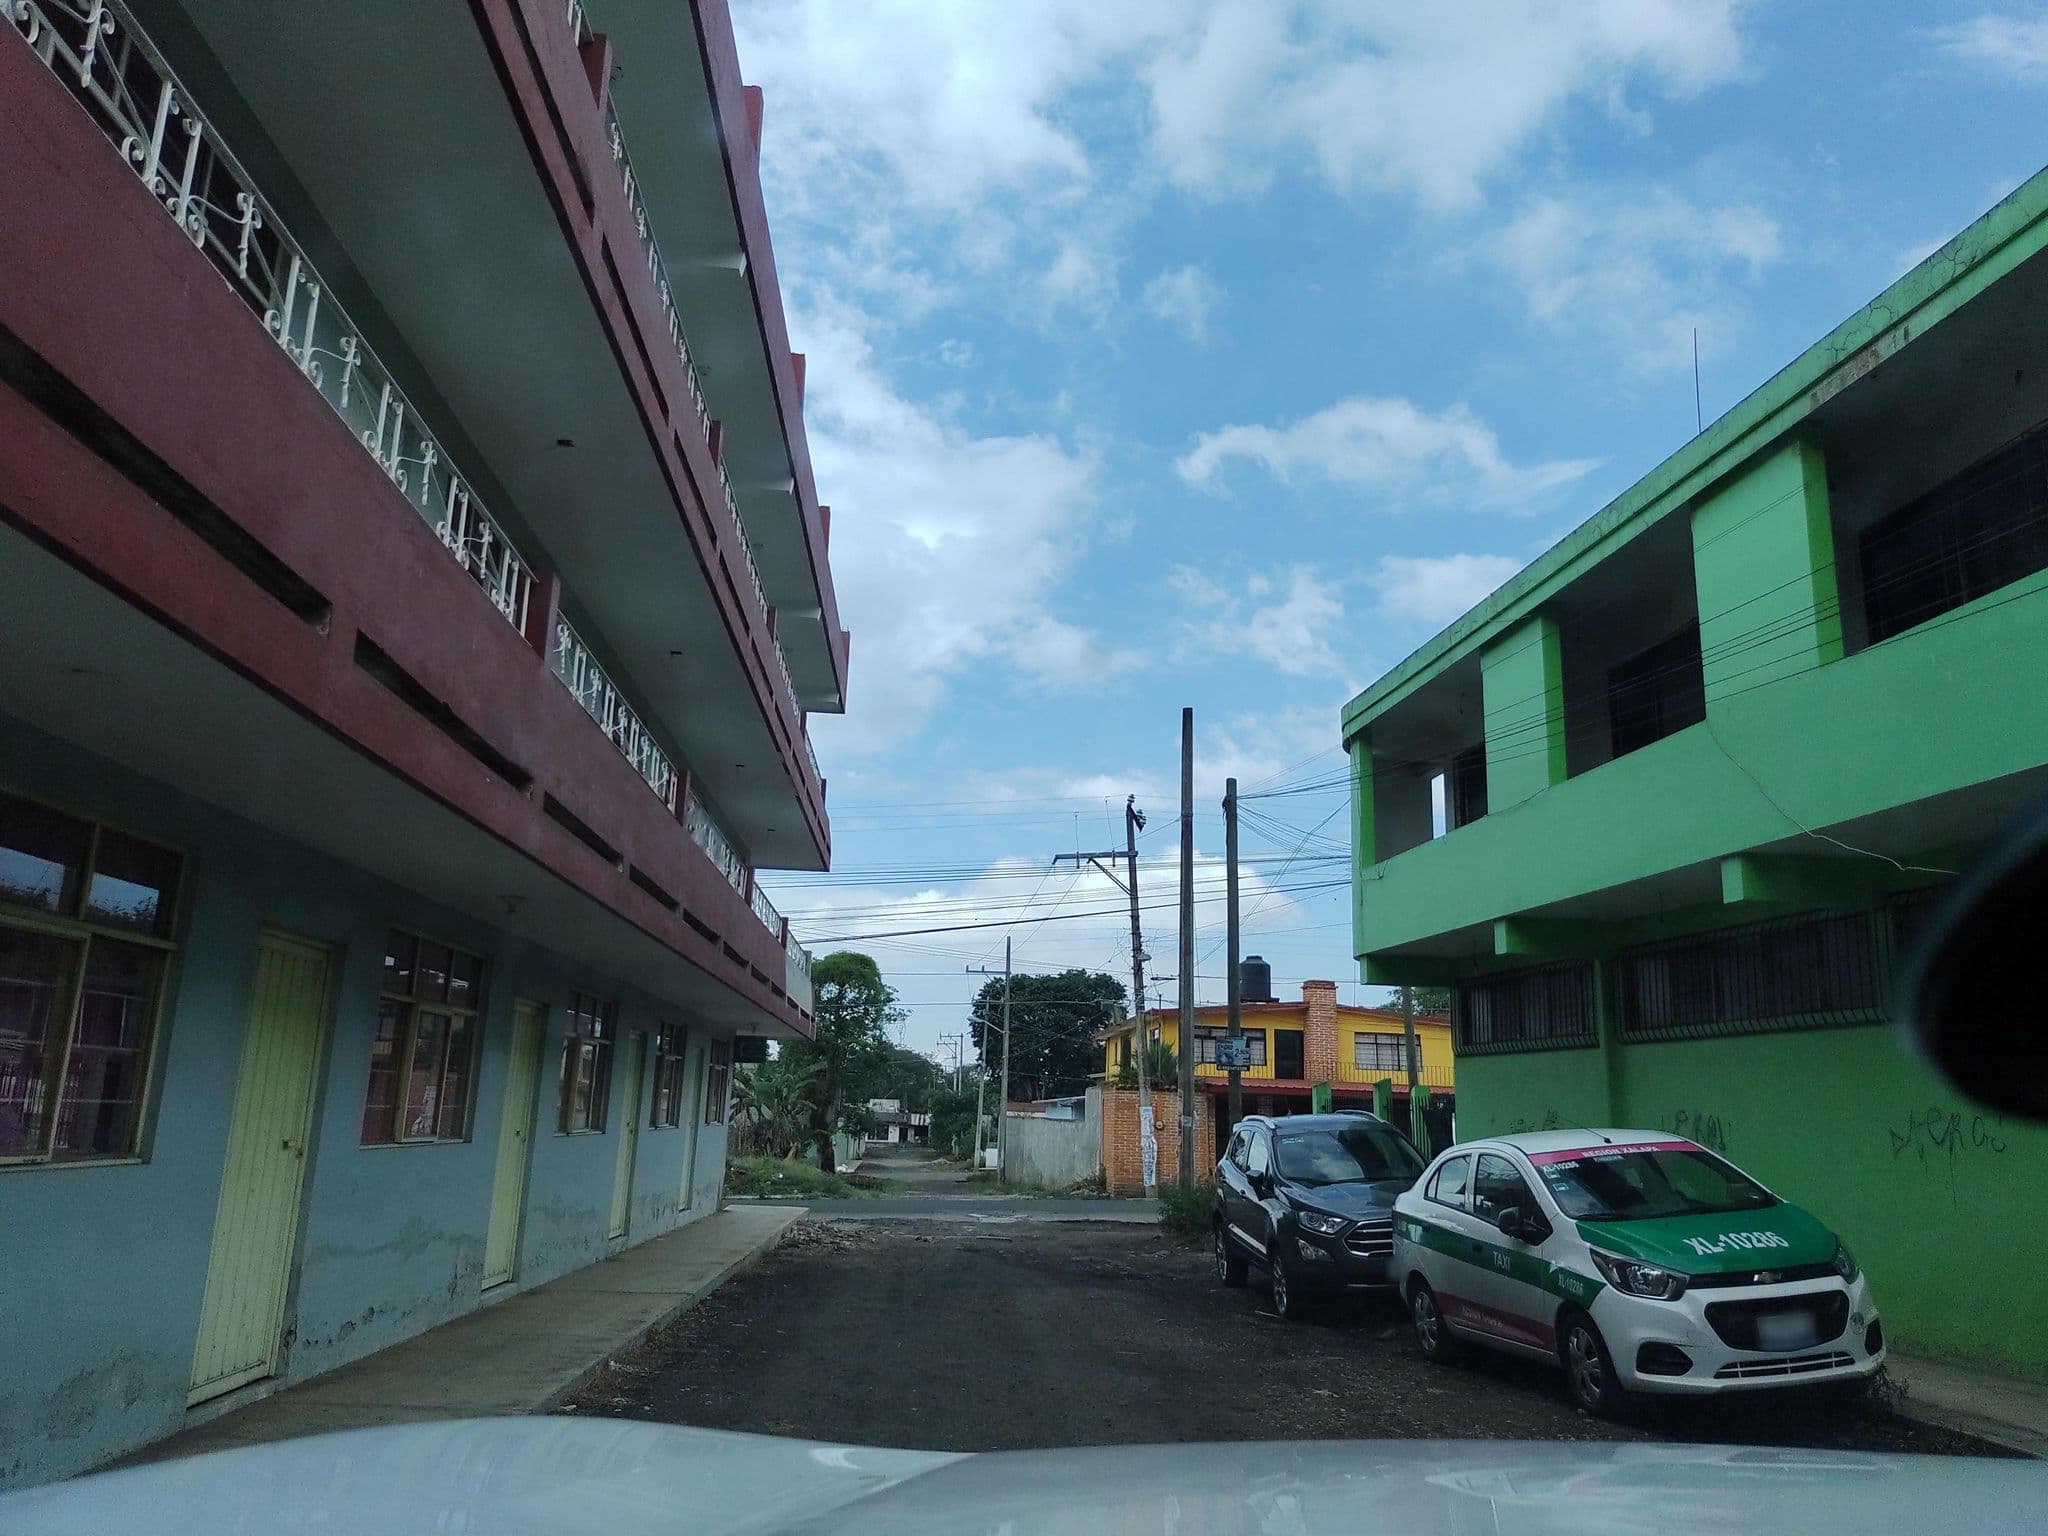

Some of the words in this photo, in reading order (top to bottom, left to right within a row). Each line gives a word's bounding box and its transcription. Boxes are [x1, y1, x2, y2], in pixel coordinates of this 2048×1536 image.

[1581, 1148, 1620, 1158] REGION
[1622, 1145, 1660, 1155] XALAPA
[1682, 1231, 1789, 1256] XL-10286
[1493, 1250, 1511, 1273] TAXI
